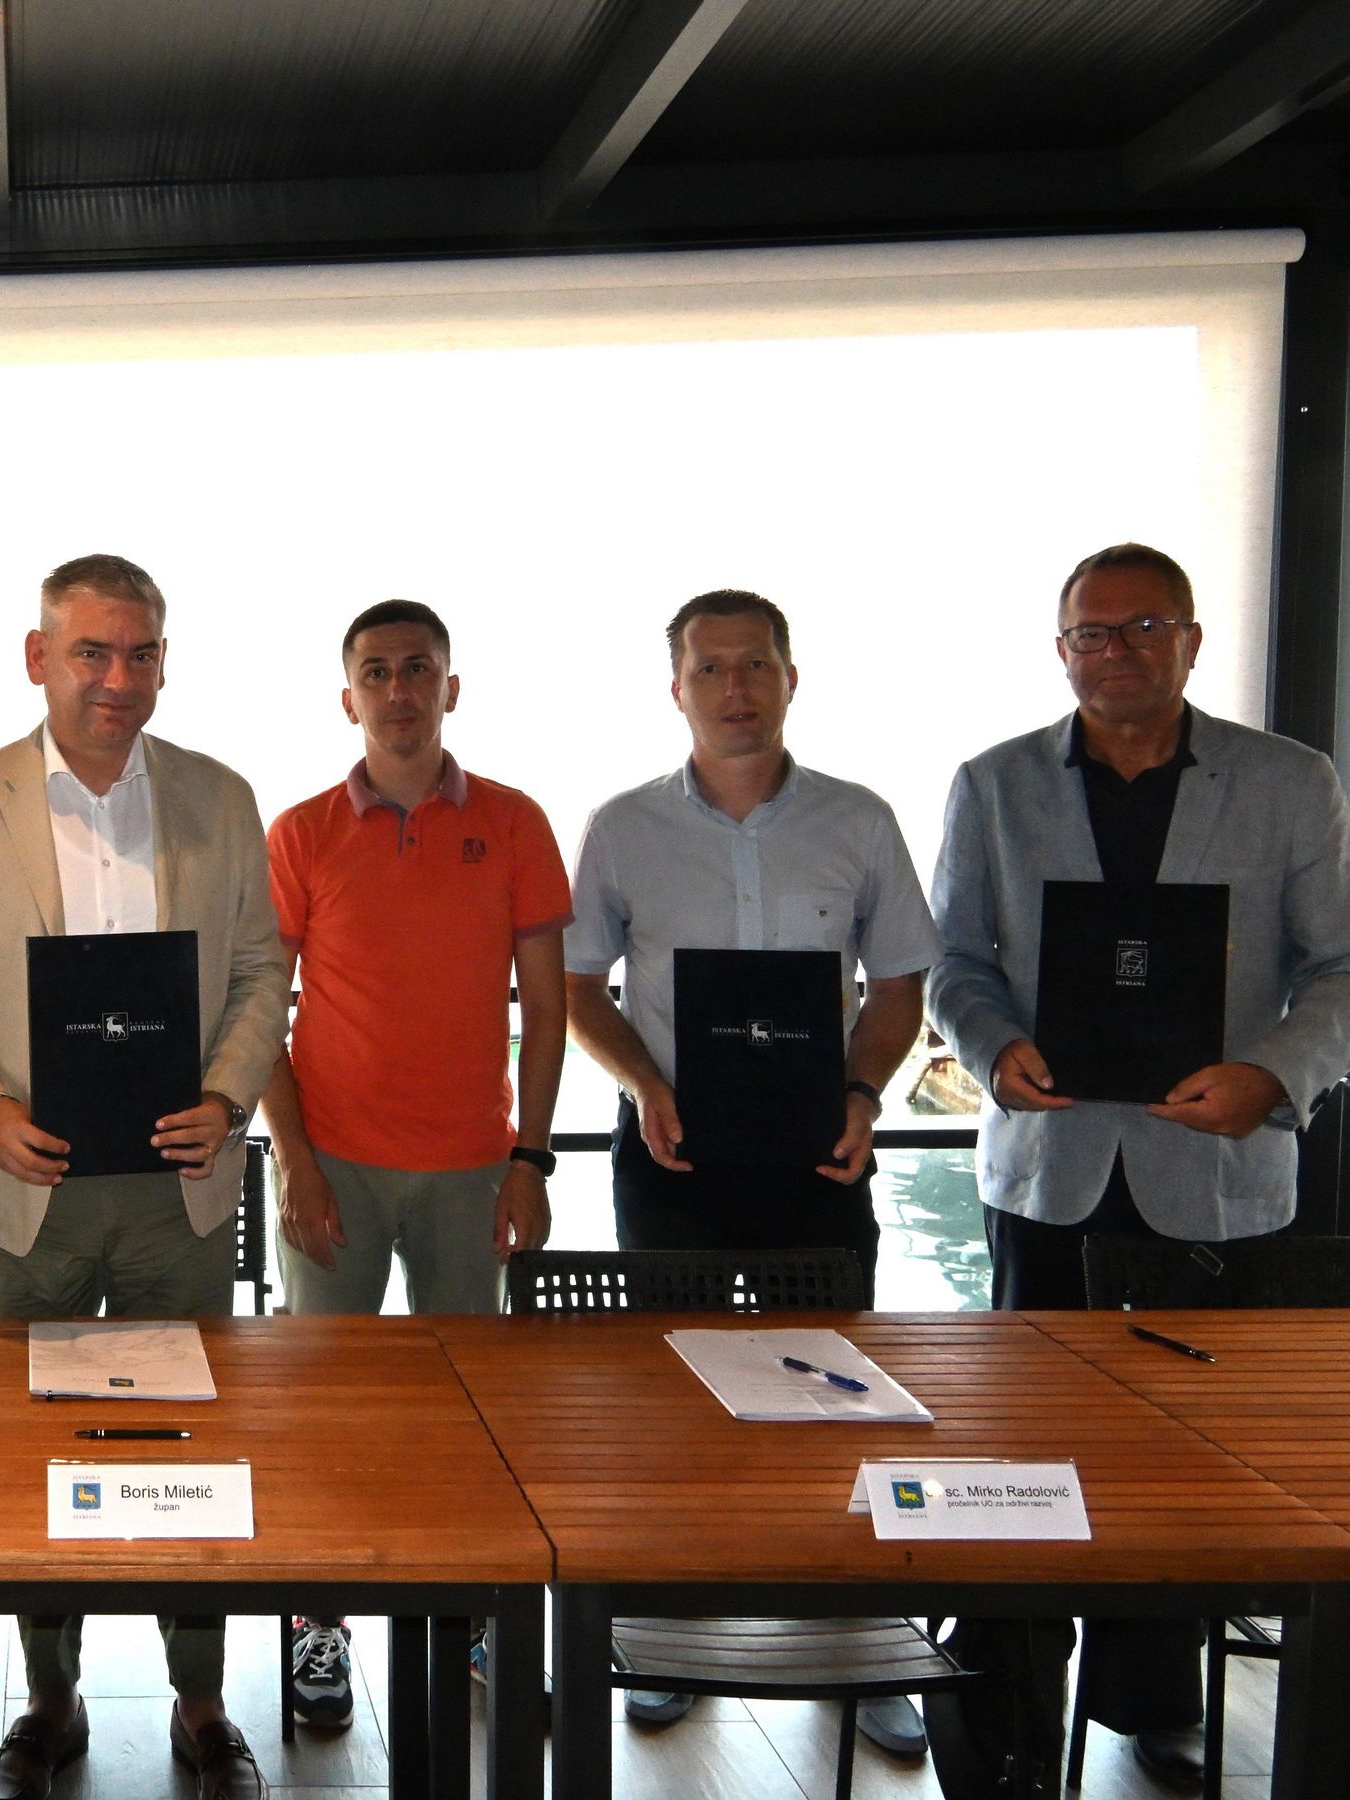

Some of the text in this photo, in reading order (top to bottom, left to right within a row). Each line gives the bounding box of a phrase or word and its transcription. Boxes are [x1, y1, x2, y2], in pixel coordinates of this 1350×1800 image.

[130, 1024, 165, 1032] ISTRIANA
[121, 1484, 214, 1499] Boris Miletić
[945, 1488, 963, 1498] sc.
[967, 1485, 1003, 1498] Mirko
[1006, 1485, 1070, 1498] Radolović
[153, 1503, 180, 1511] župan
[947, 1500, 979, 1508] pročelnik
[1006, 1499, 1029, 1507] održivi
[1031, 1500, 1052, 1508] razvoj
